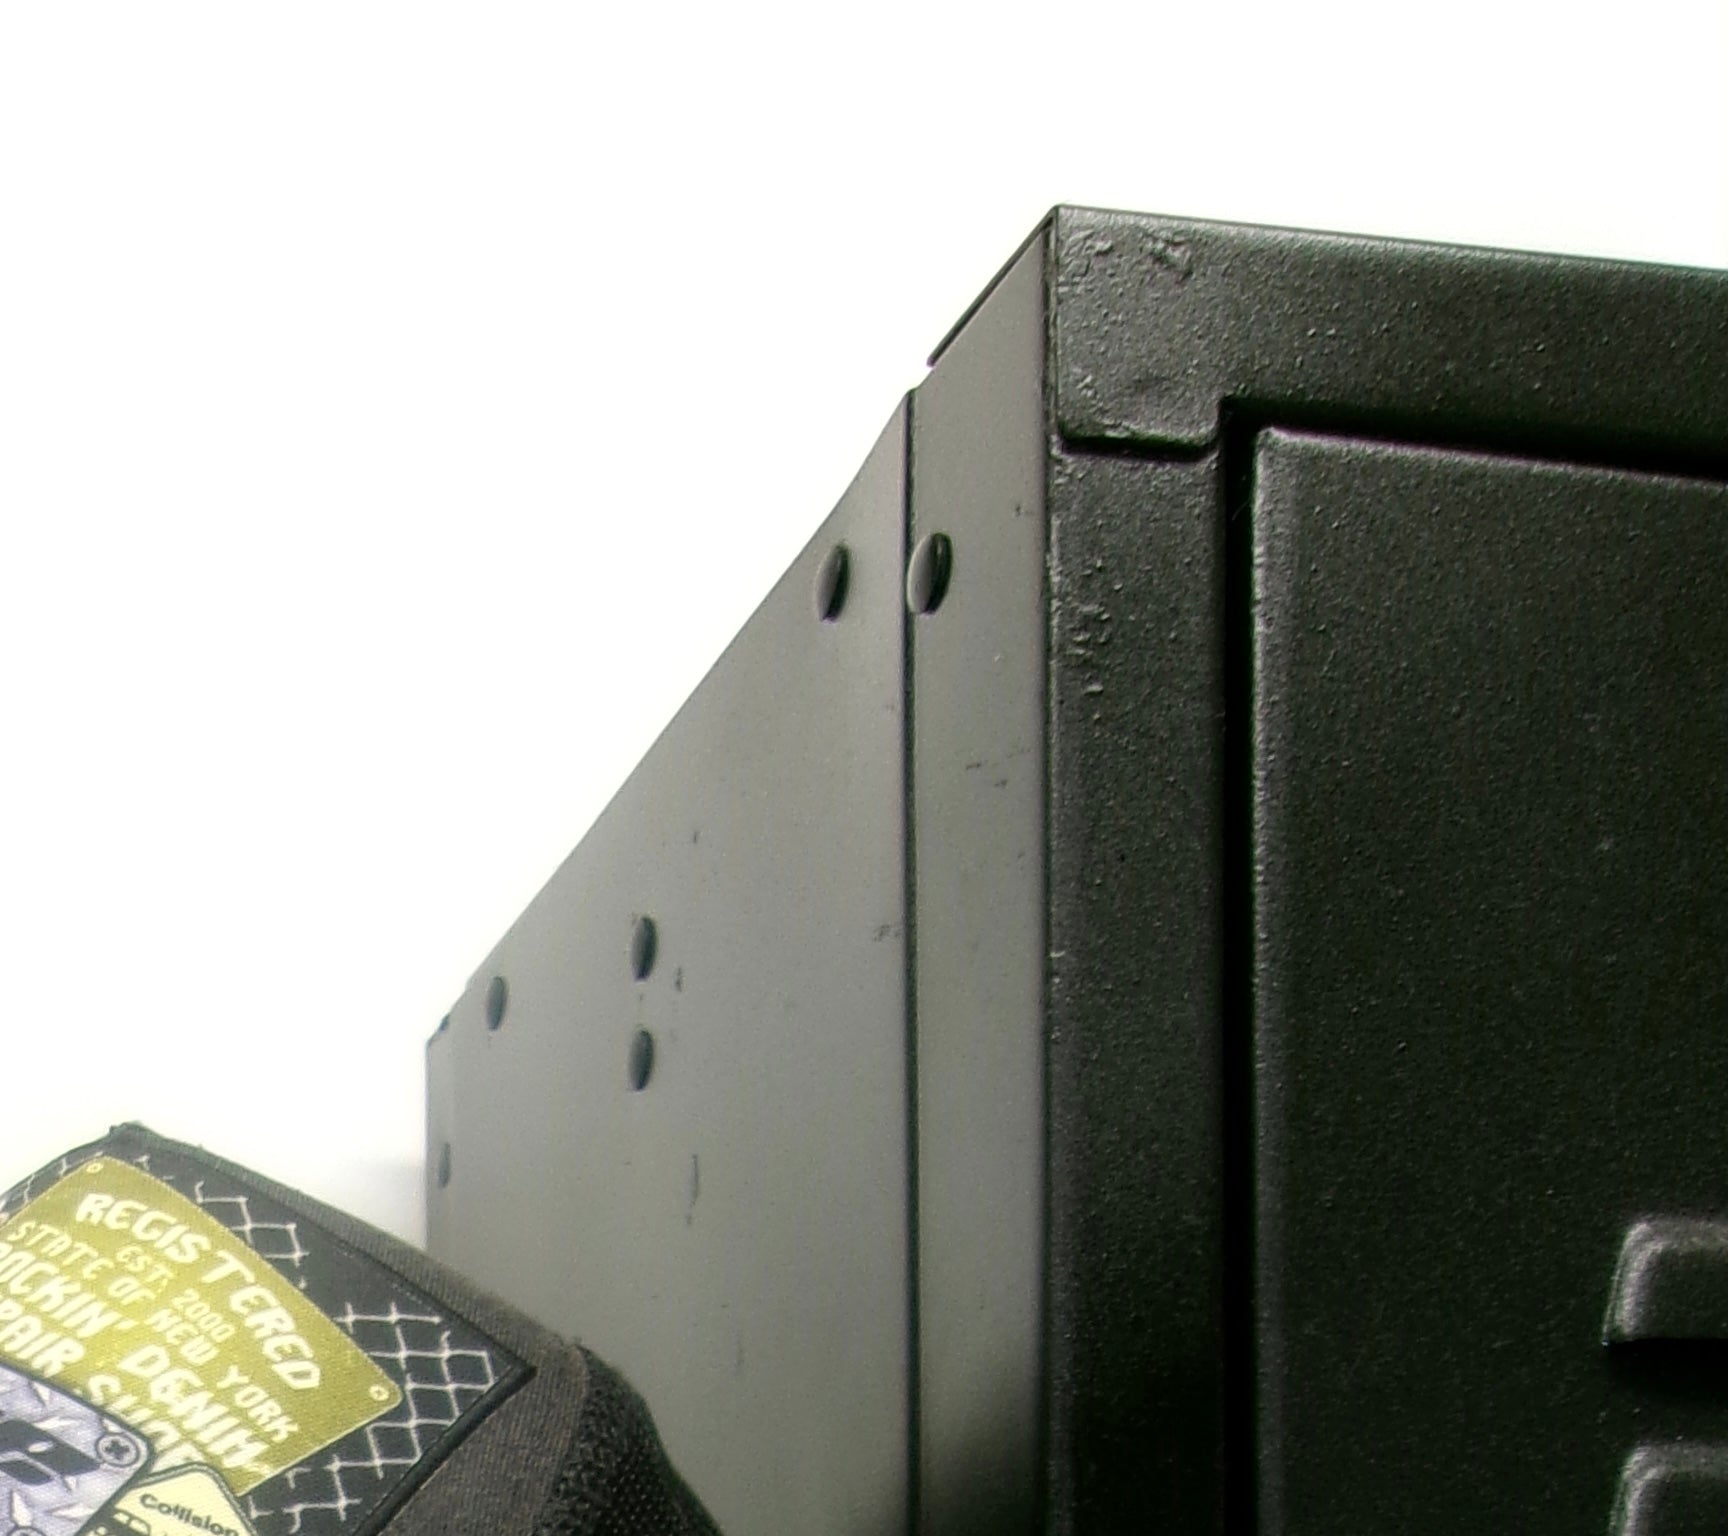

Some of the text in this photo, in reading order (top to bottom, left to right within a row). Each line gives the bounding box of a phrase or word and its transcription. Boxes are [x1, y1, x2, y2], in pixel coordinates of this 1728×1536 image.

[7, 1220, 300, 1443] STATE OF NEW YORK
[76, 1193, 321, 1390] REGISTERED
[171, 1288, 236, 1344] 2000
[116, 1343, 271, 1470] DENIM
